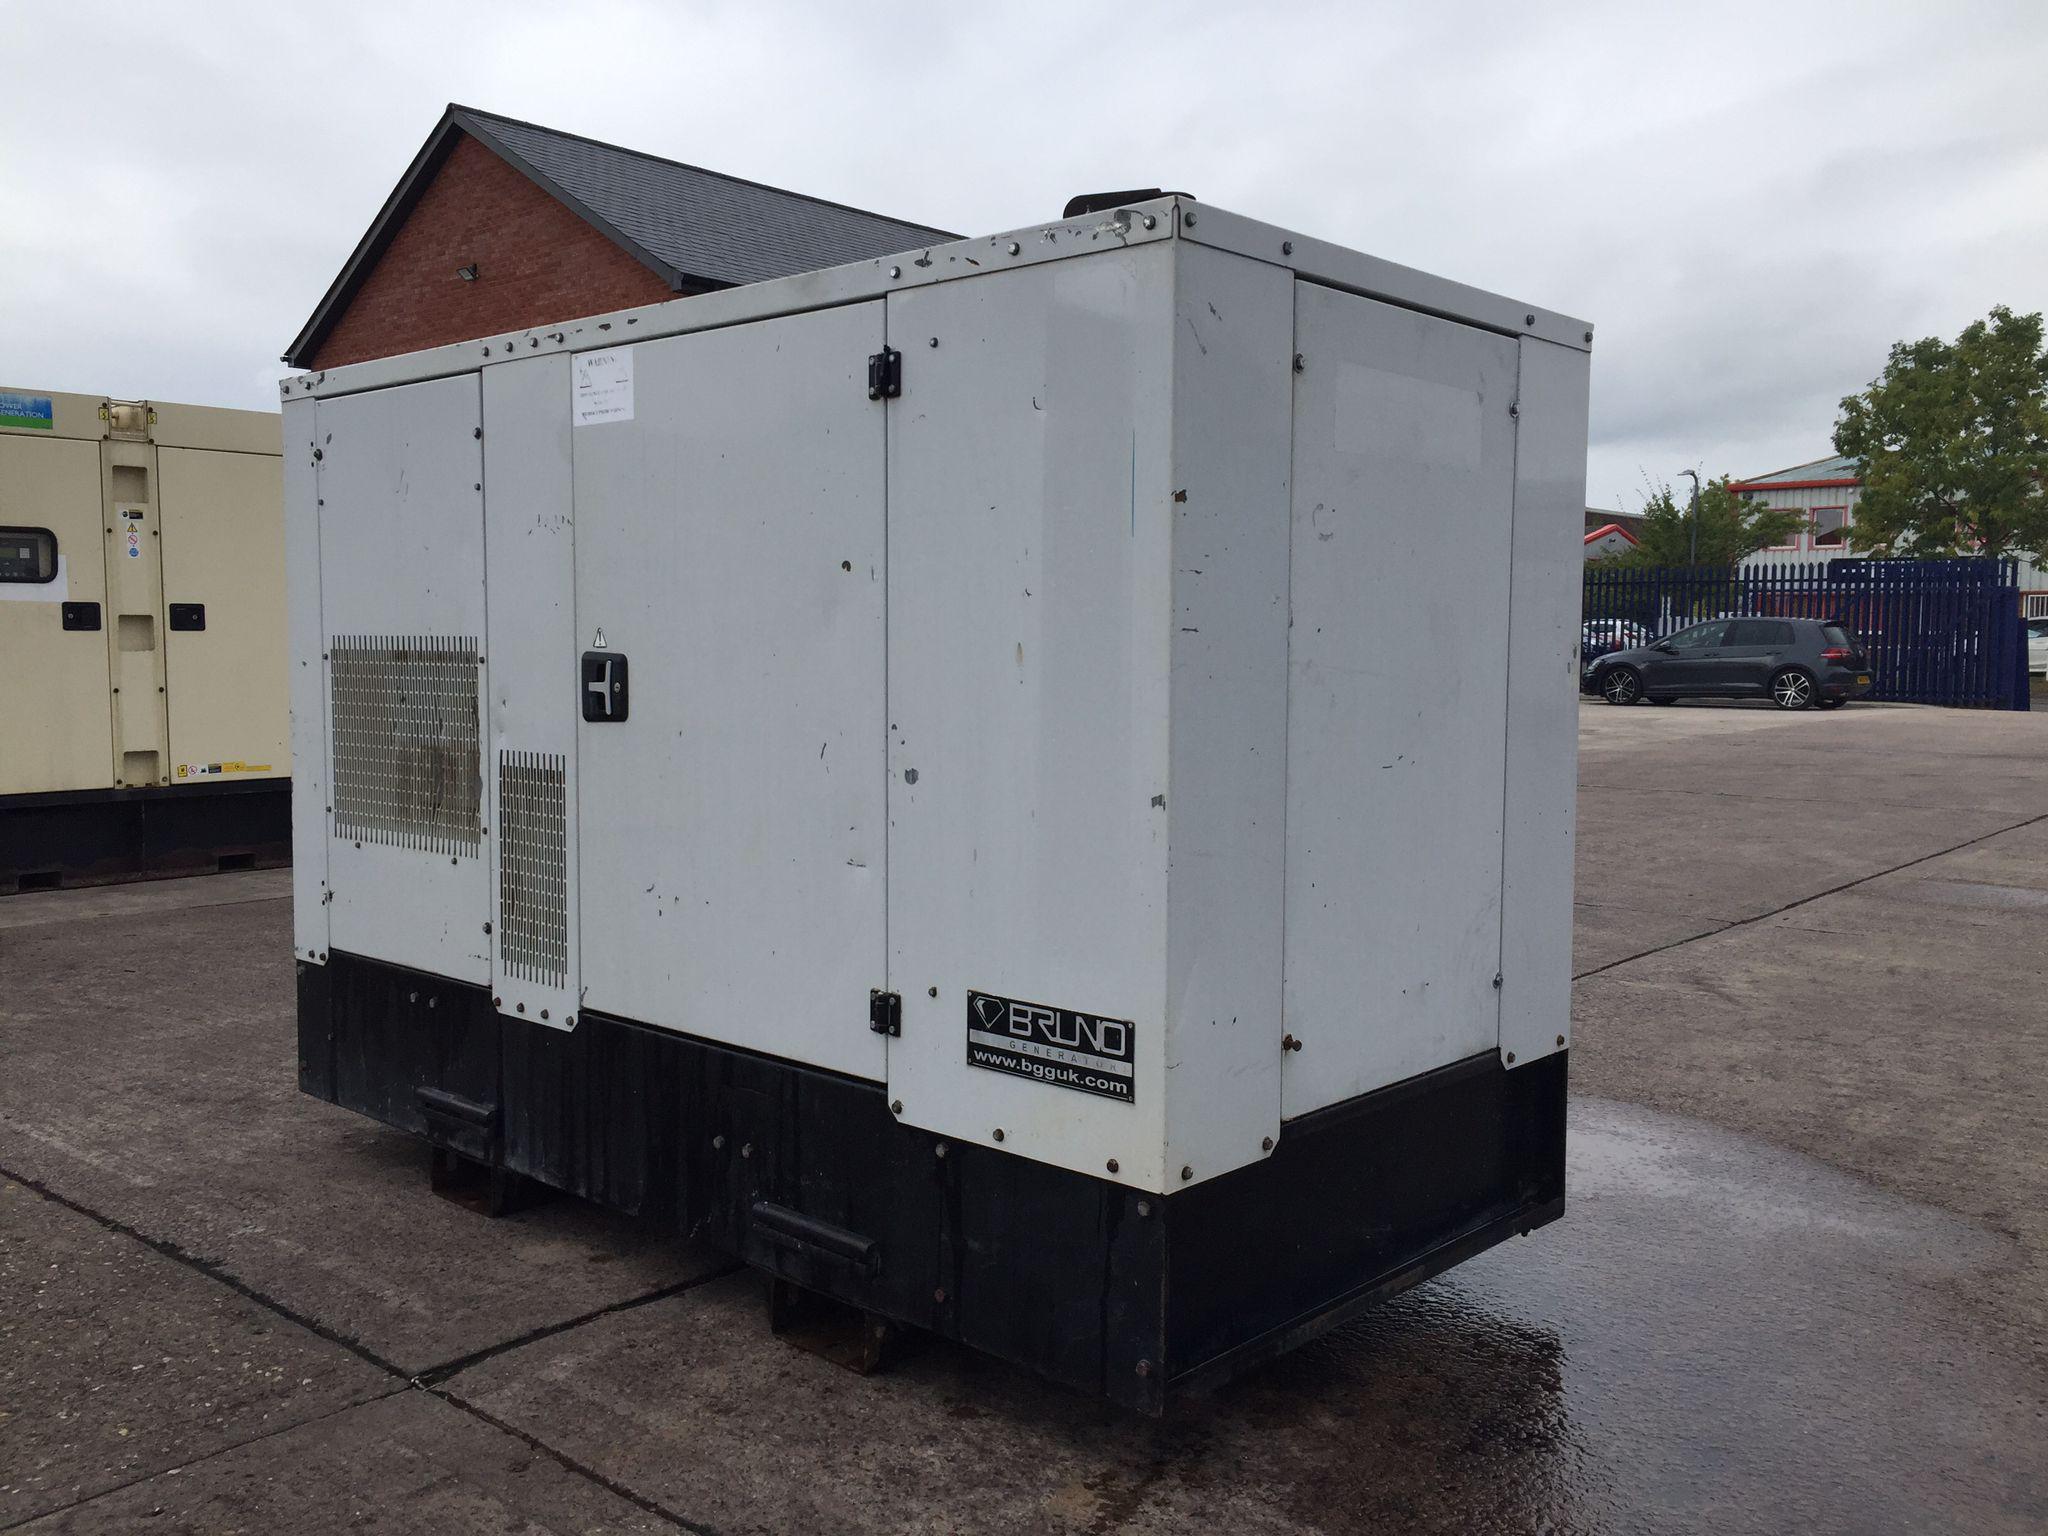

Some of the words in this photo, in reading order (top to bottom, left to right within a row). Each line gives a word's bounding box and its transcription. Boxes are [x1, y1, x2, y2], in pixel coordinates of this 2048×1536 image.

[0, 402, 23, 410] OWER
[0, 409, 45, 418] ENERATION
[1009, 1002, 1126, 1056] BRUNO
[973, 1050, 1128, 1094] www.bgguk.com
